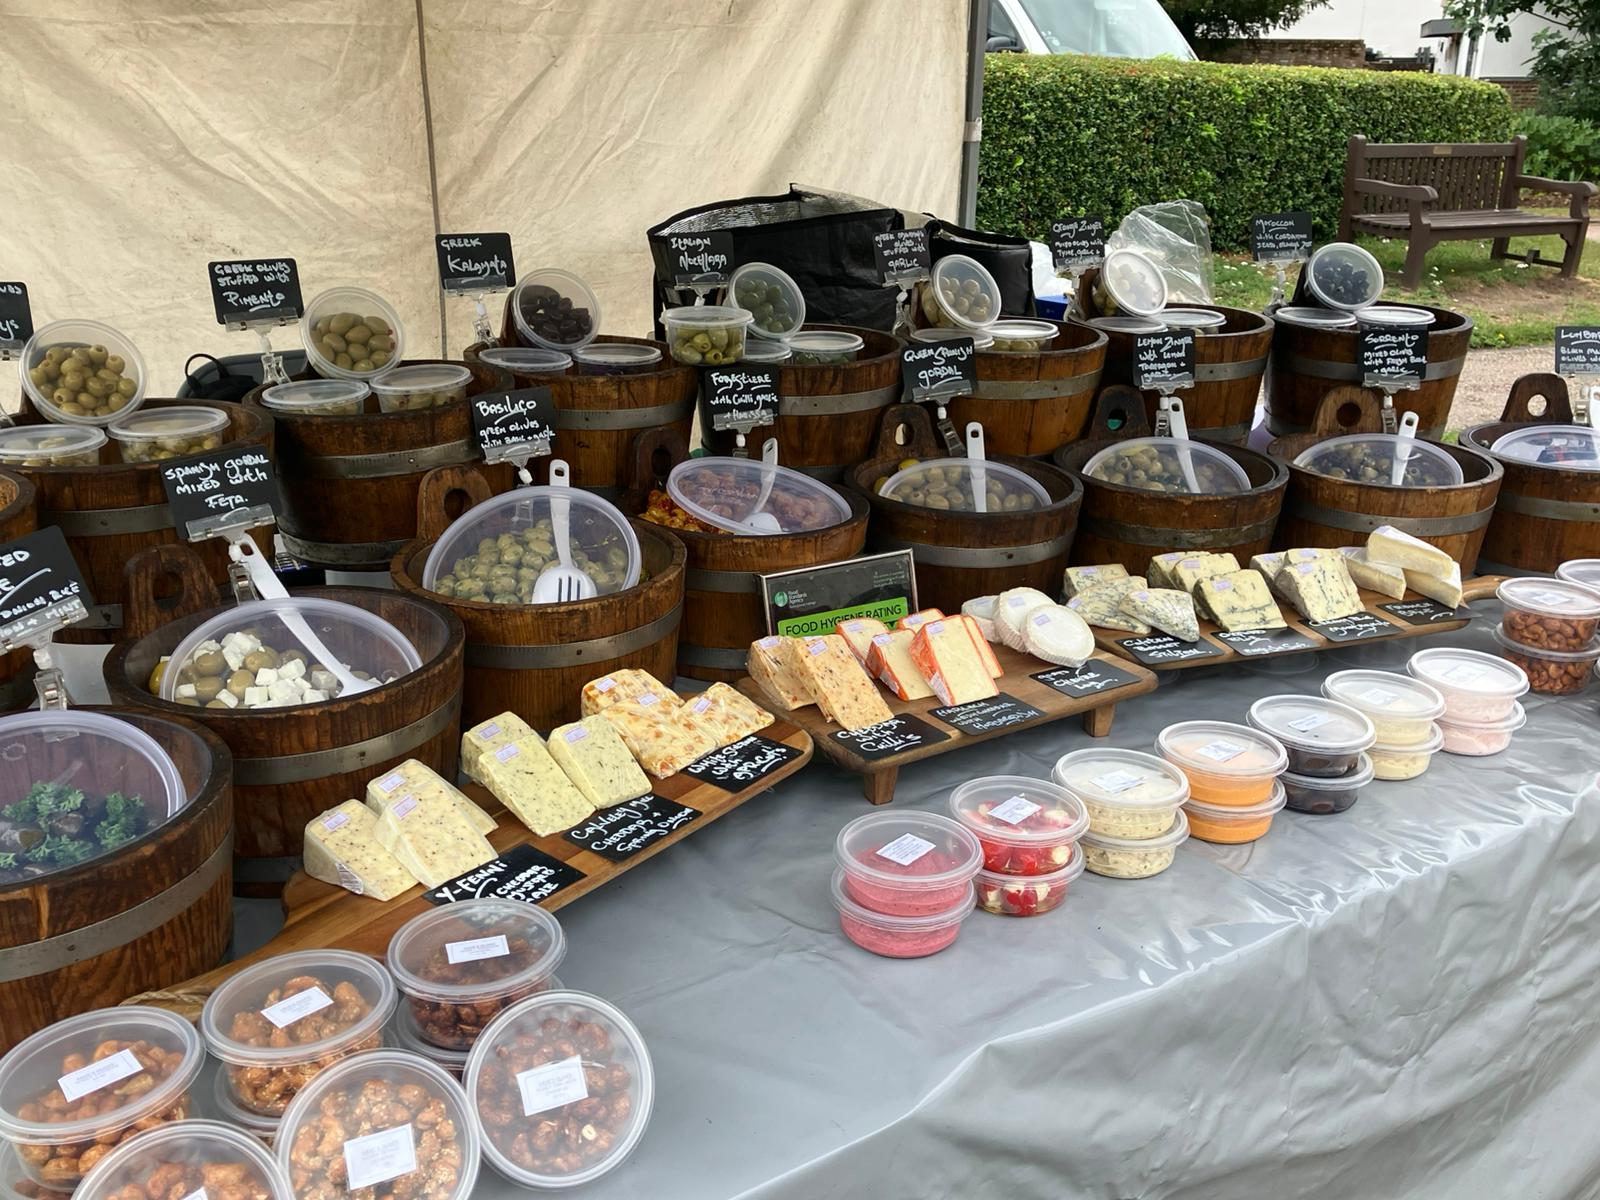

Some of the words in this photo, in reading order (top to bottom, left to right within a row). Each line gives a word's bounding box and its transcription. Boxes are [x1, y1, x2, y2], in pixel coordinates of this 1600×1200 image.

[440, 238, 482, 251] GREEK
[176, 479, 220, 495] MIXED
[0, 550, 30, 567] ED
[785, 621, 818, 636] FOOD
[820, 611, 863, 630] HYGIENE
[865, 604, 902, 619] RATING
